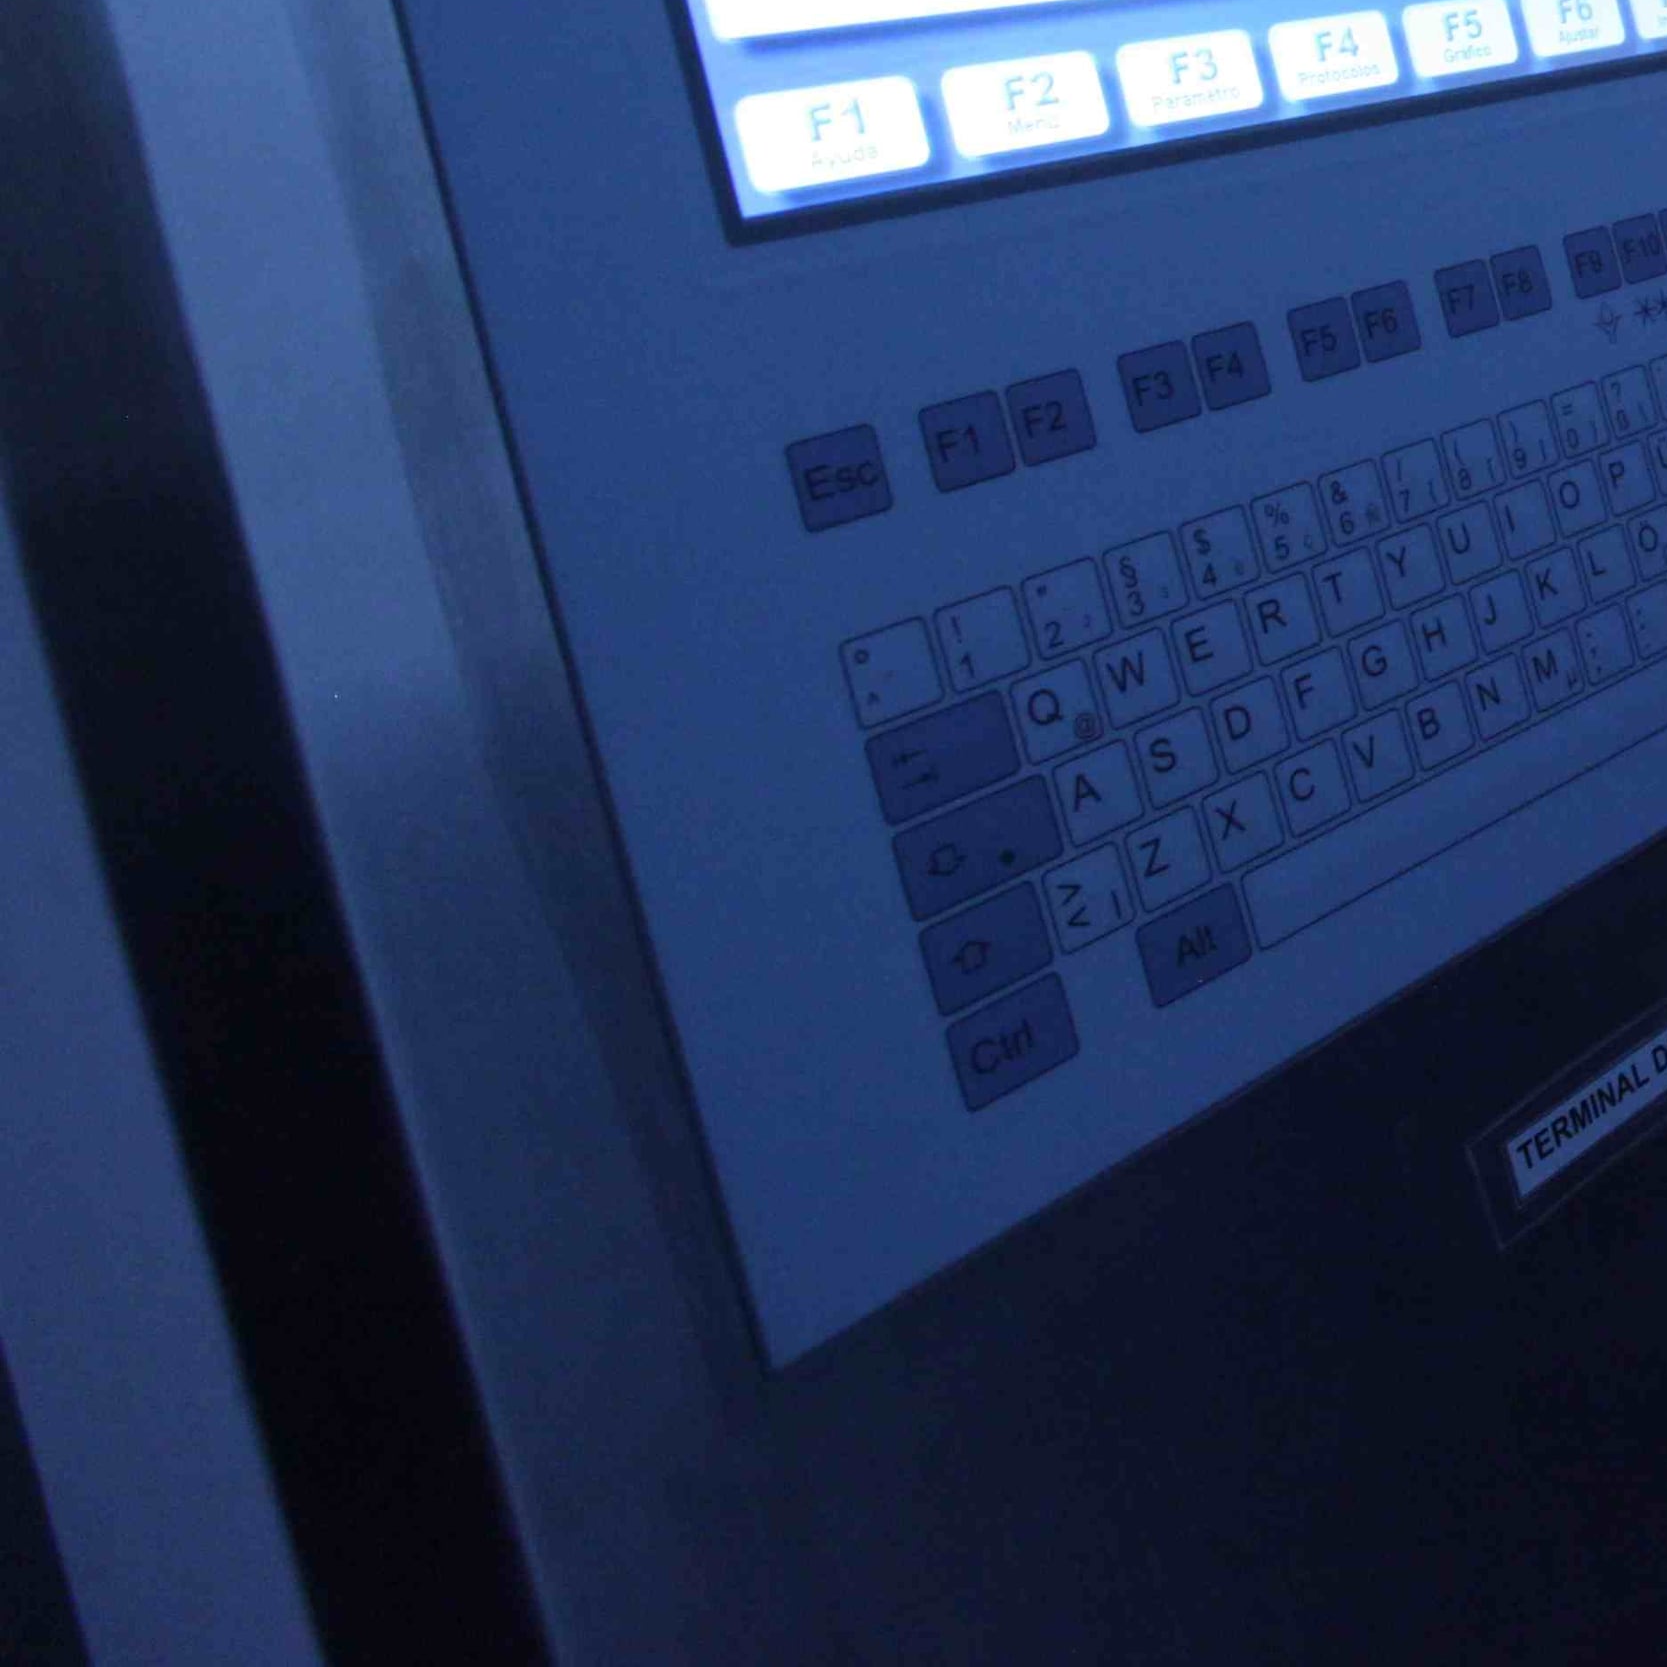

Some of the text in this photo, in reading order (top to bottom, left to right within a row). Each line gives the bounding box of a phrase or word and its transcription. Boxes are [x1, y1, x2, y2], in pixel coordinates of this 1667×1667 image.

[804, 97, 868, 144] F1
[999, 68, 1061, 112] F2
[1166, 45, 1220, 86] F3
[1311, 26, 1360, 63] F4
[1441, 8, 1483, 42] F5
[1448, 284, 1476, 314] F7
[1622, 233, 1661, 264] F10
[805, 308, 1398, 501] Esc F1 F2 F3 F4 F5 F6
[1027, 688, 1064, 727] Q
[1105, 651, 1146, 694] W
[1184, 626, 1215, 663] E
[1257, 599, 1288, 634] R
[1322, 571, 1343, 605] T
[1385, 546, 1407, 578] Y
[1447, 522, 1472, 555] U
[1558, 480, 1581, 510] O
[1608, 460, 1626, 490] P
[1072, 773, 1103, 812] A
[1148, 737, 1177, 774] S
[1224, 705, 1252, 741] D
[1294, 672, 1314, 710] F
[1361, 644, 1389, 677] G
[1421, 616, 1448, 653] H
[1483, 594, 1498, 626] J
[1534, 568, 1559, 602] K
[1586, 551, 1607, 577] L
[1138, 649, 1560, 878] Z X C V B N M
[1175, 926, 1218, 968] Alt
[970, 1019, 1034, 1074] Ctrl
[1516, 1064, 1650, 1170] TERMINAL
